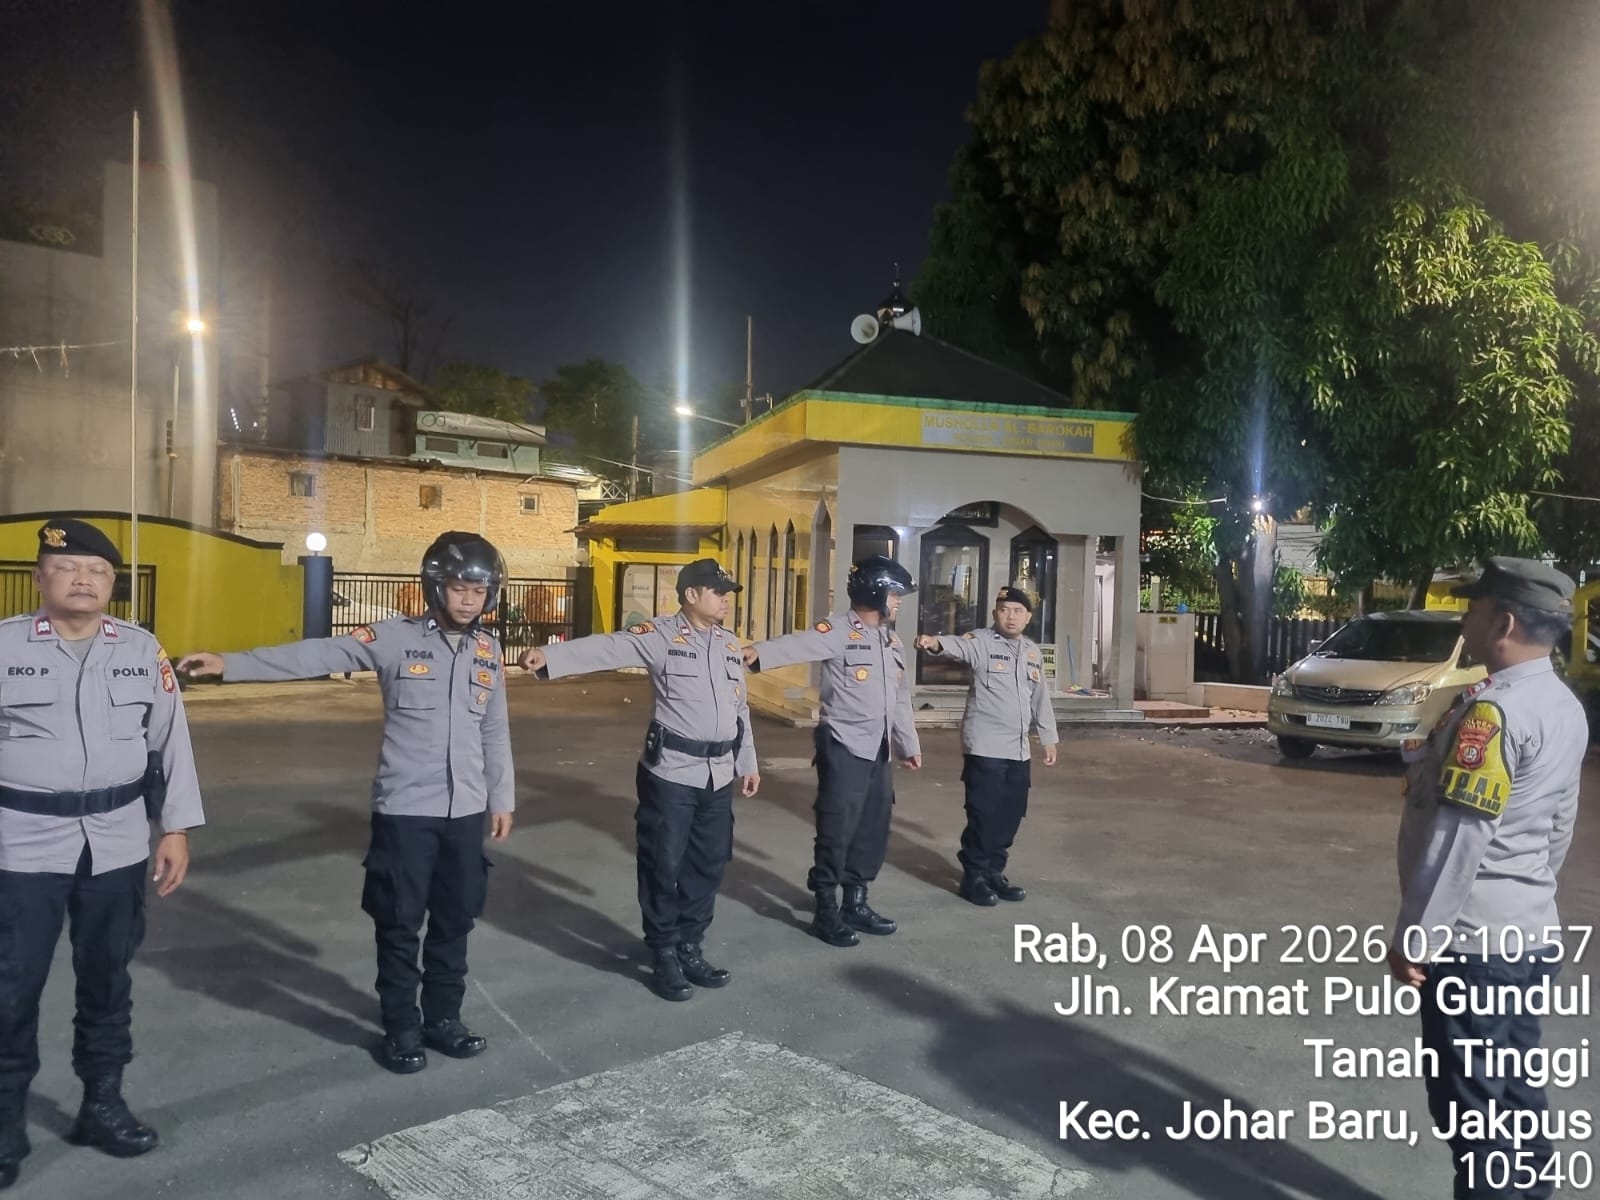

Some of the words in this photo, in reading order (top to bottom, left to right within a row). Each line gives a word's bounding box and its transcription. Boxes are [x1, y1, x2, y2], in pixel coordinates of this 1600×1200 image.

[405, 650, 434, 660] YOGA
[7, 666, 35, 677] EKO
[40, 667, 49, 677] P
[112, 667, 149, 678] POLRI
